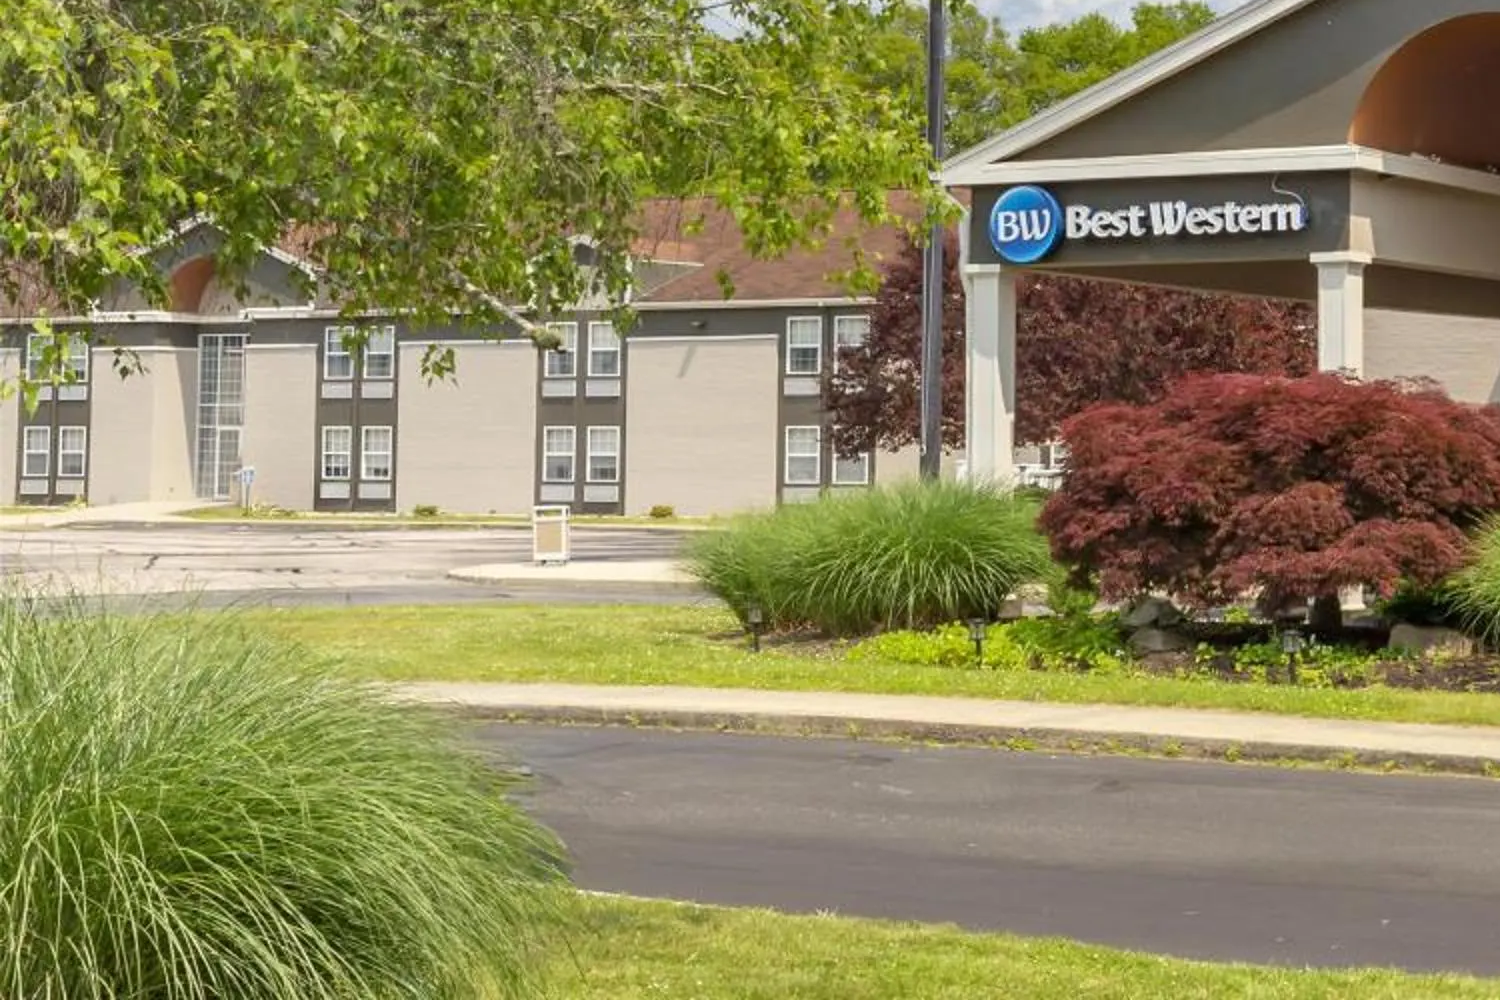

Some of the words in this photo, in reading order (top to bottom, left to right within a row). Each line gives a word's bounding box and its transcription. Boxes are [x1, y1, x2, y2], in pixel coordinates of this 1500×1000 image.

[997, 208, 1051, 242] BW
[1065, 203, 1147, 239] Best
[1149, 199, 1305, 236] Western
